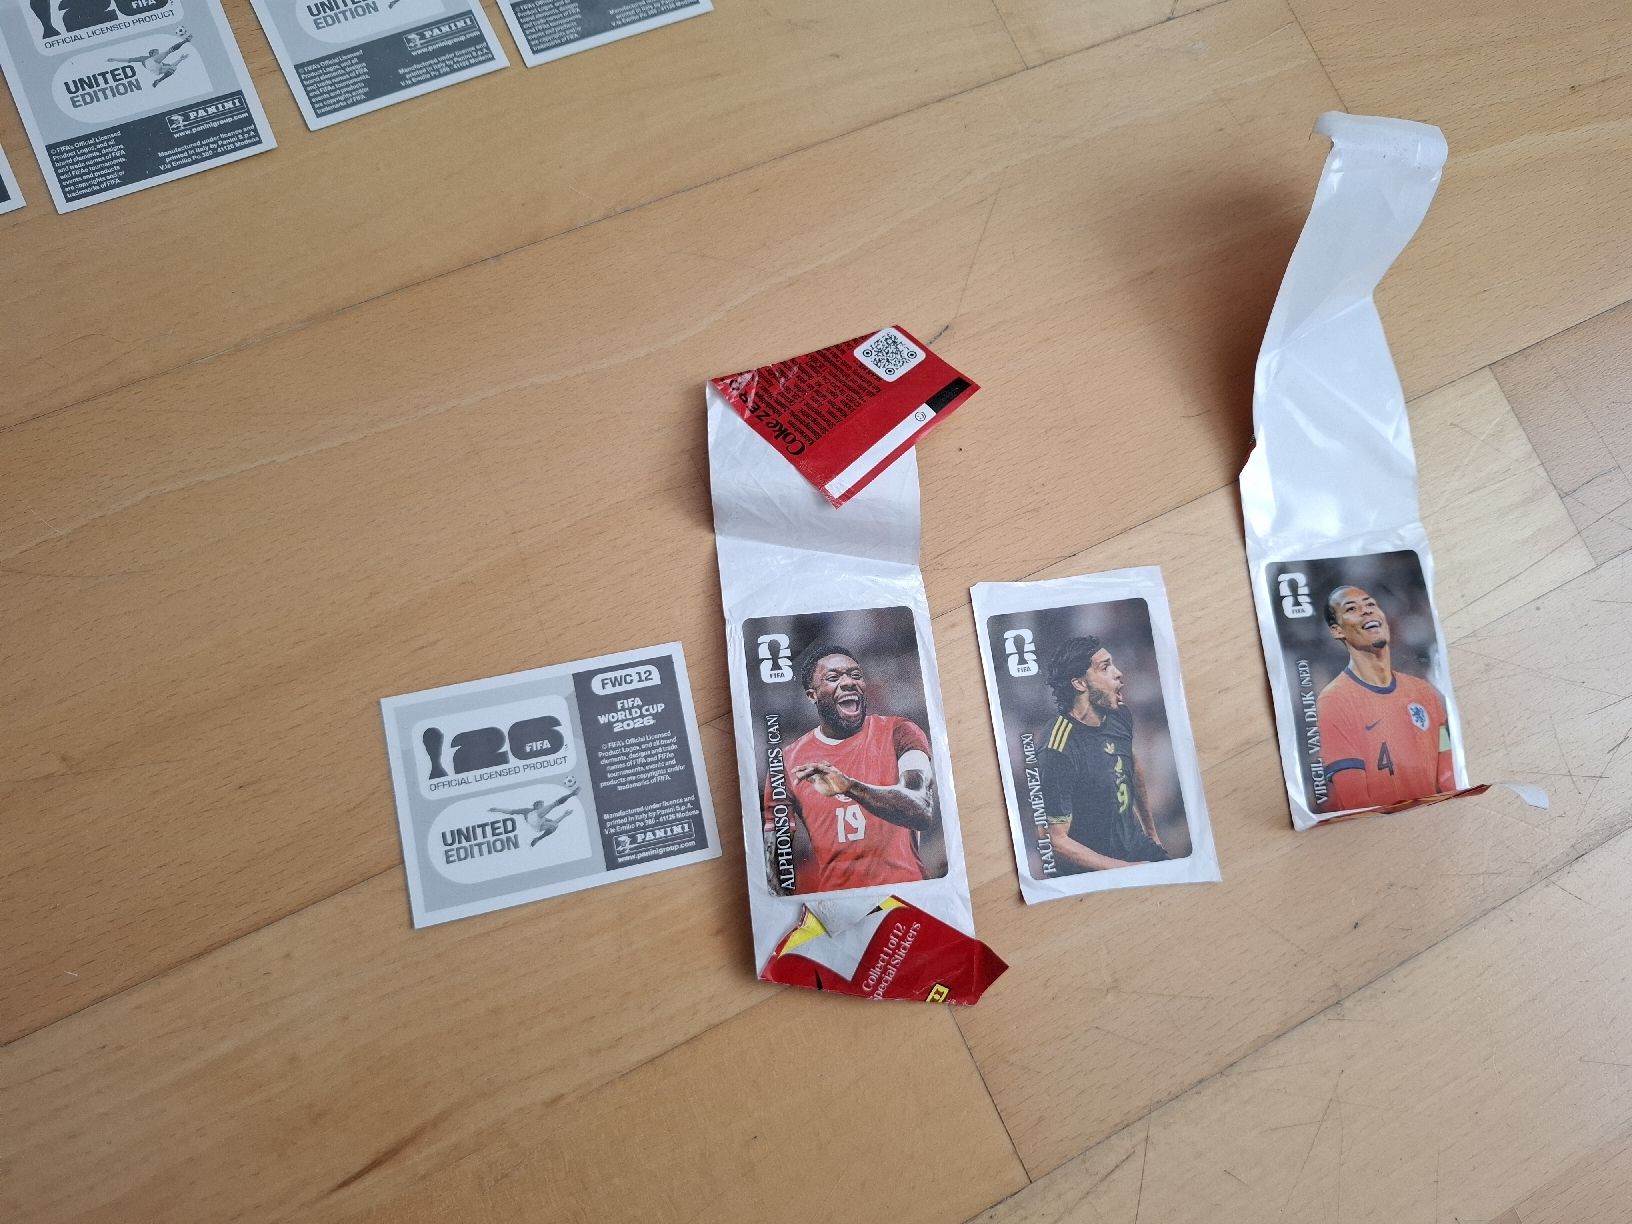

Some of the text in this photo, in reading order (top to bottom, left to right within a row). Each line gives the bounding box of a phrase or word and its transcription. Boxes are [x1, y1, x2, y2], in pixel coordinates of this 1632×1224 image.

[45, 10, 175, 49] OFFICIAL LICENSED PRODUCT
[313, 1, 379, 30] EDITION
[423, 17, 472, 38] PANINI
[64, 64, 136, 95] UNITED
[70, 78, 142, 109] EDITION
[187, 98, 241, 119] PANINI
[172, 111, 249, 138] www.paninigroup.com
[765, 417, 805, 455] Coke
[600, 669, 653, 689] FWC 12
[597, 702, 665, 724] WORLD CUP
[616, 696, 642, 709] FIFA
[1301, 691, 1318, 721] DIJK
[612, 715, 654, 732] 2026
[526, 739, 551, 752] FIFA
[1306, 726, 1321, 754] VAN
[429, 756, 568, 792] OFFICIAL LICENSED PRODUCT
[1377, 742, 1394, 776] 4
[1311, 758, 1329, 804] VIRGIL
[766, 714, 796, 890] ALPHONSO DAVIES (CAN)
[1026, 767, 1048, 829] JIMÉNEZ
[442, 818, 516, 847] UNITED
[635, 823, 690, 842] PANINI
[836, 805, 866, 843] 19
[445, 834, 519, 864] EDITION
[617, 839, 696, 863] www.paninigroup.com
[1037, 833, 1056, 874] RAÚL
[862, 954, 889, 991] Collect
[888, 933, 898, 948] of
[894, 923, 906, 936] 12
[891, 922, 920, 967] Stickers
